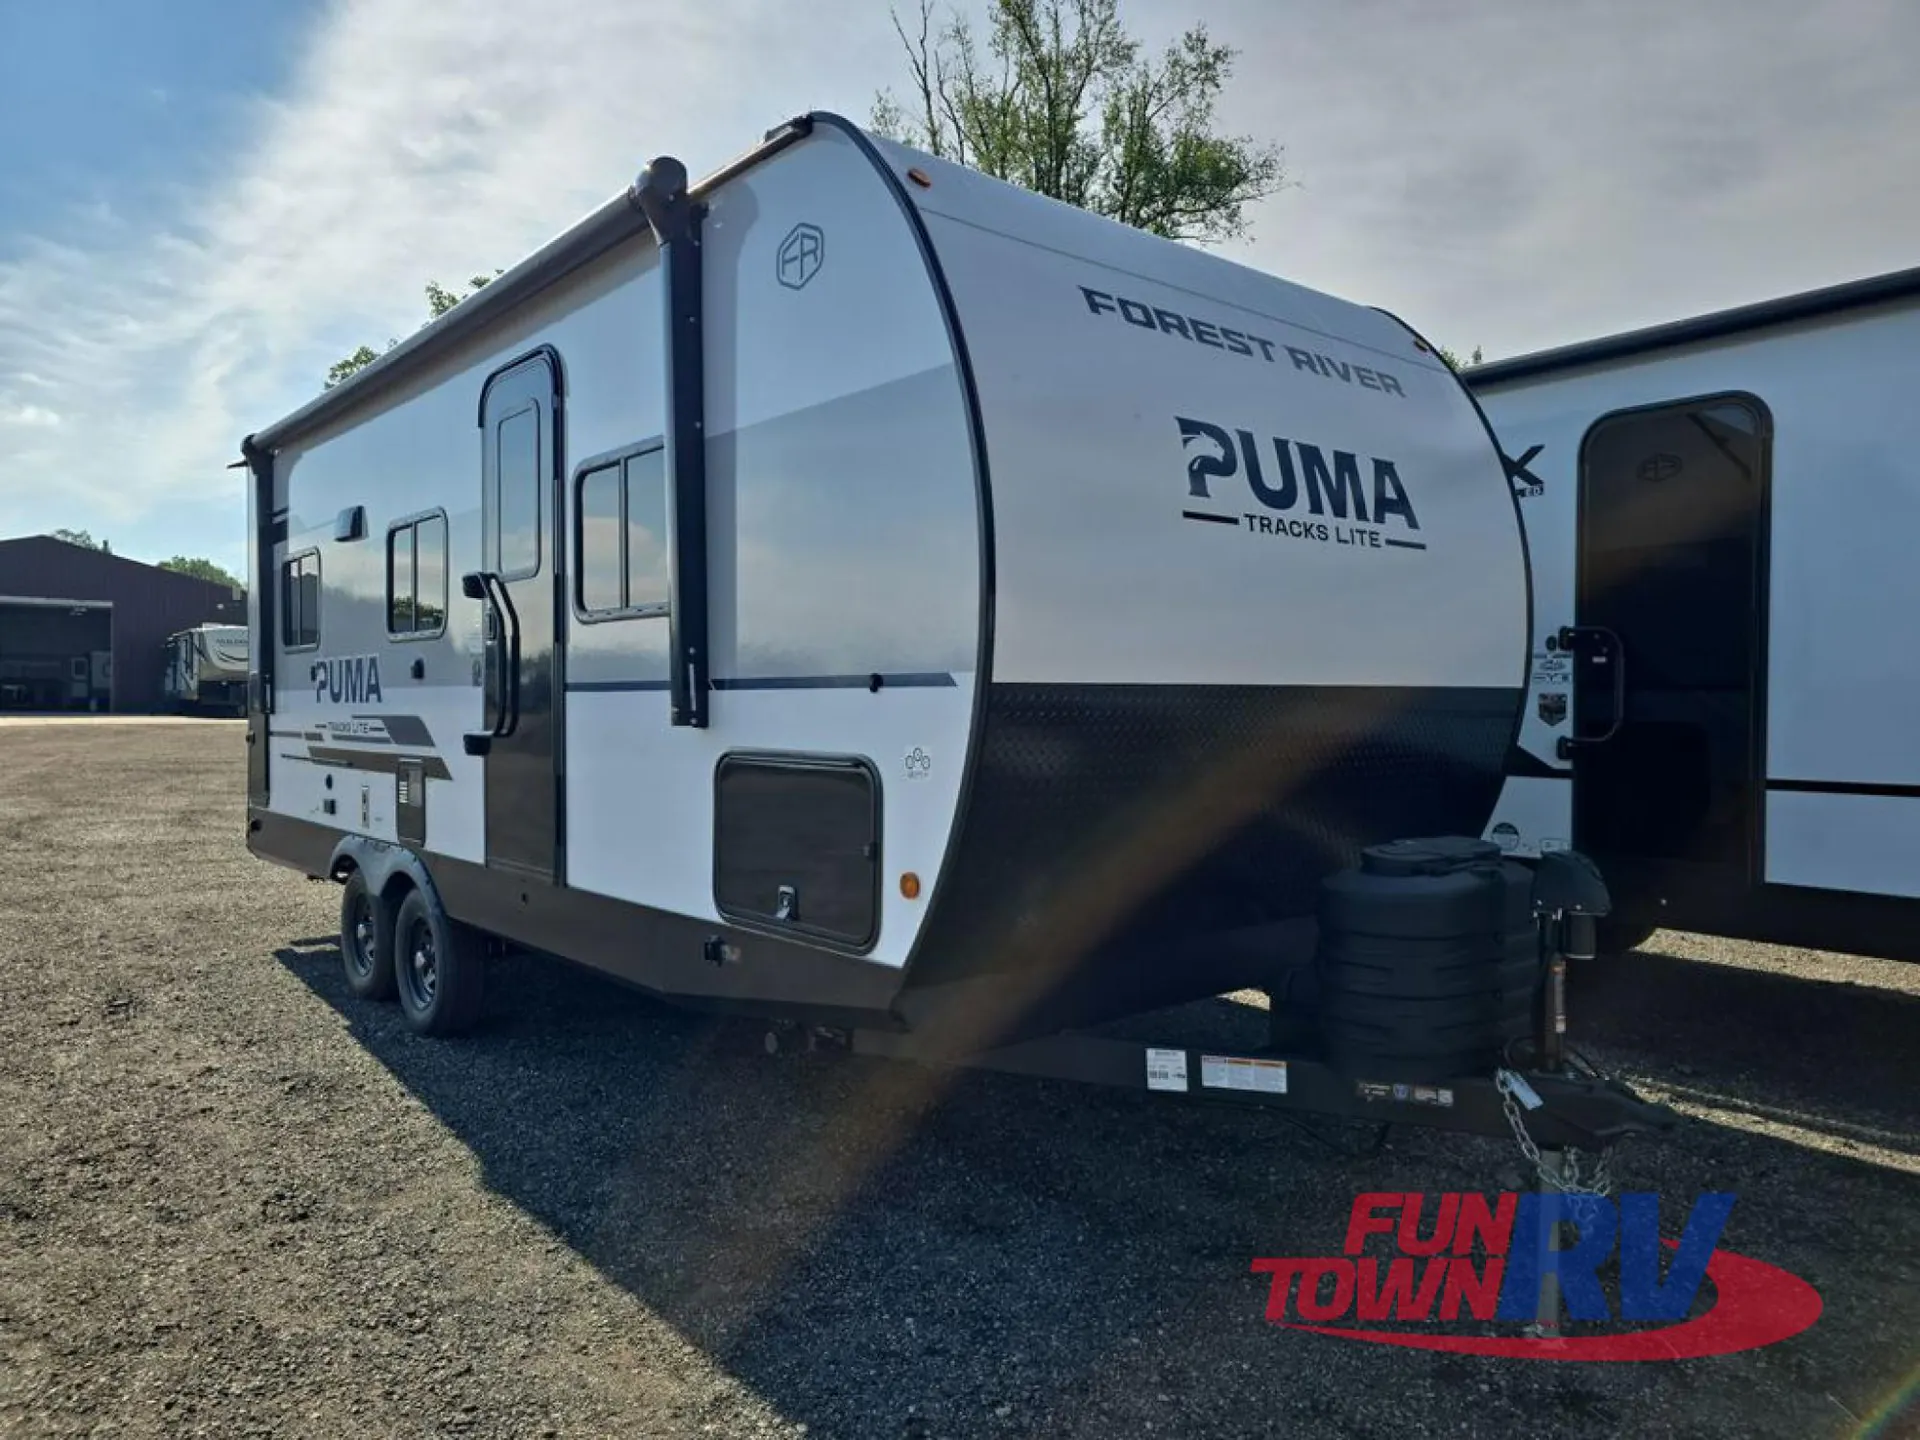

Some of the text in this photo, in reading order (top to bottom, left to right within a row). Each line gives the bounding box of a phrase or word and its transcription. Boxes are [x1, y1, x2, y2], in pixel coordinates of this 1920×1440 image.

[1078, 285, 1407, 397] FOREST RIVER
[1174, 416, 1420, 530] PUMA
[1243, 513, 1382, 548] TRACKS LITE
[311, 655, 382, 703] PUMA
